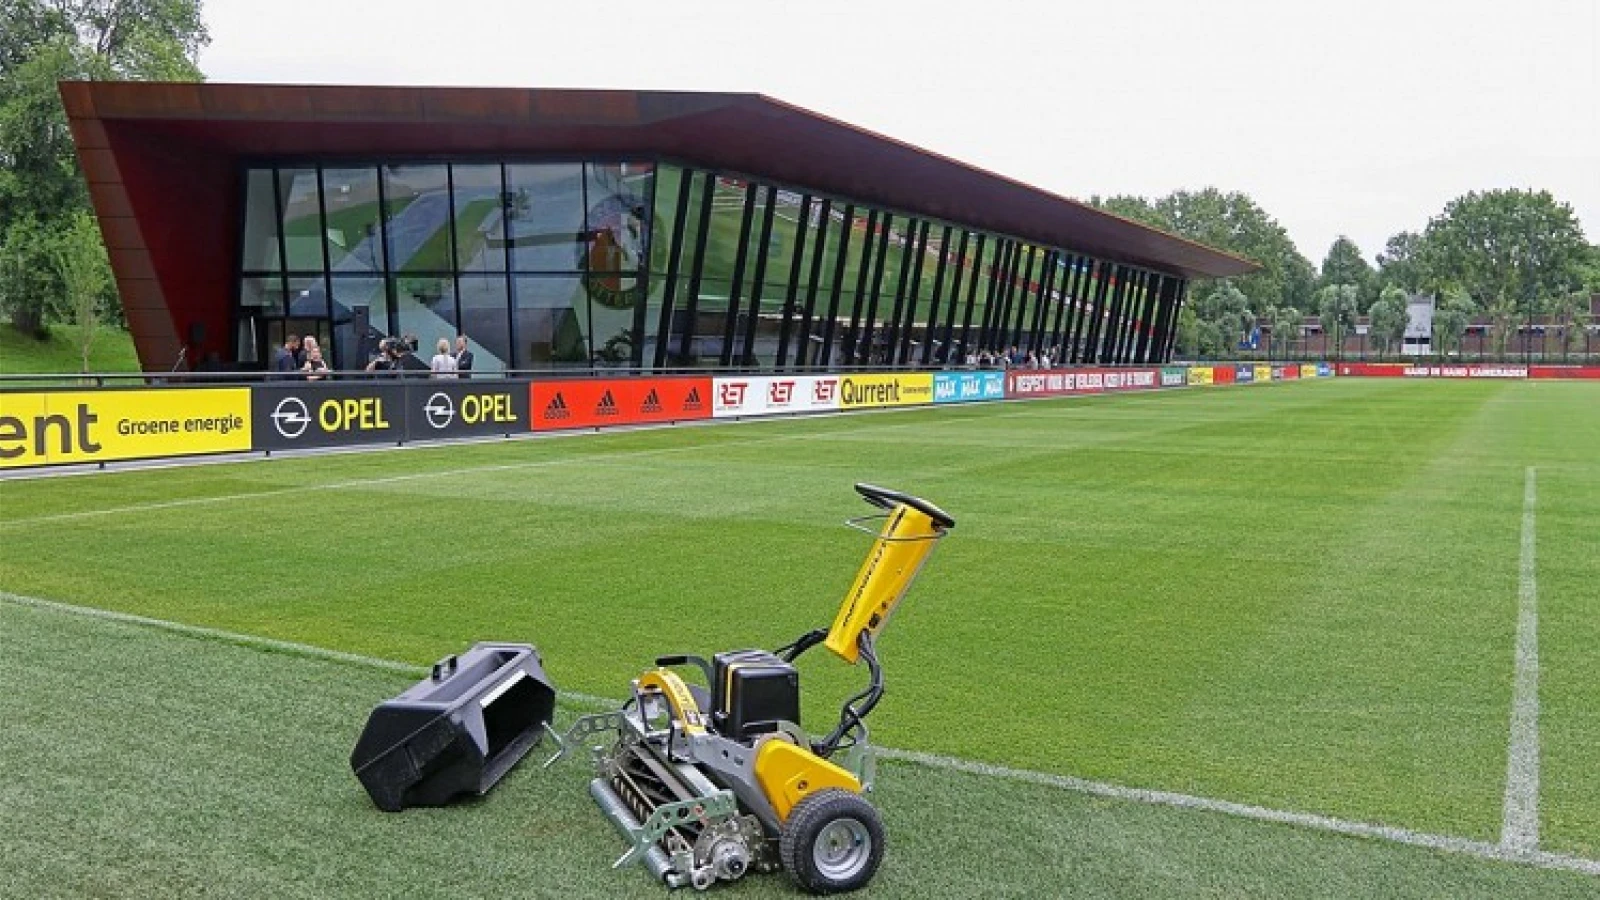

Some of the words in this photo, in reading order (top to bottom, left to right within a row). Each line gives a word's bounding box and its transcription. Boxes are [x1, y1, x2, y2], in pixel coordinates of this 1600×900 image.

[720, 382, 748, 405] RET
[770, 382, 795, 402] RET
[815, 380, 838, 400] RET
[840, 378, 900, 404] Qurrent
[936, 379, 957, 398] MAX
[962, 378, 981, 396] MAX
[319, 397, 389, 432] OPEL
[461, 393, 518, 424] OPEL
[544, 410, 570, 419] adidas
[0, 403, 102, 458] ent
[118, 418, 179, 436] Groene
[184, 413, 244, 435] energie
